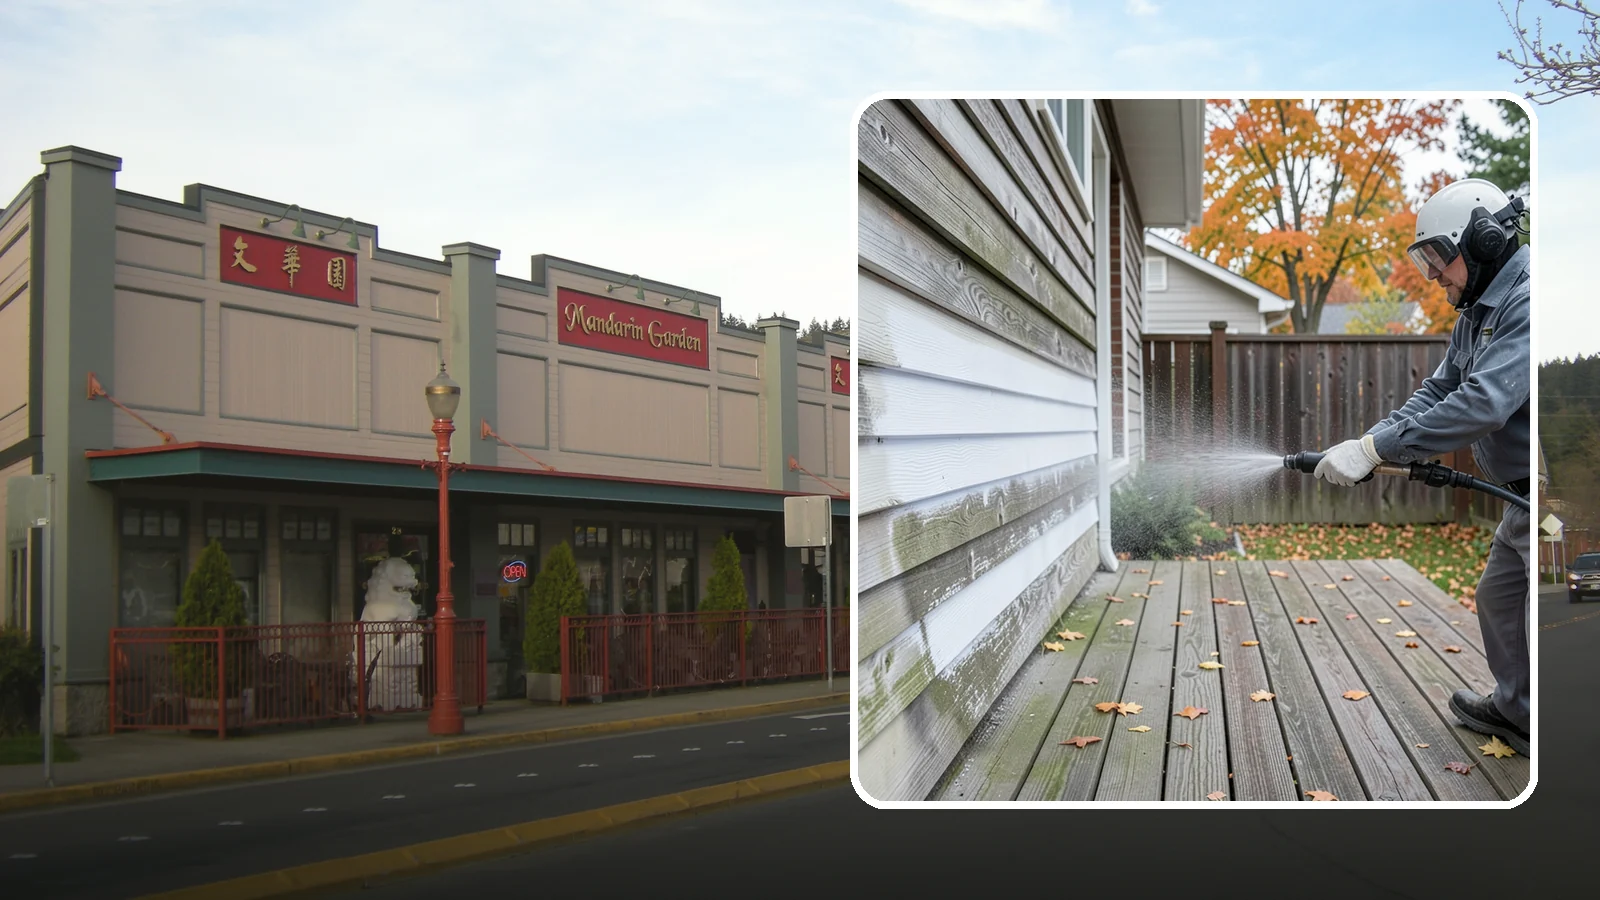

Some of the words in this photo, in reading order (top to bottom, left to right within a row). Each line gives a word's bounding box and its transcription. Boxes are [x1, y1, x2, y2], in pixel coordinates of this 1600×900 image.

[230, 235, 346, 291] 文華園
[564, 302, 644, 341] Mandarin
[647, 319, 702, 352] Garden
[503, 565, 527, 579] OPEN
